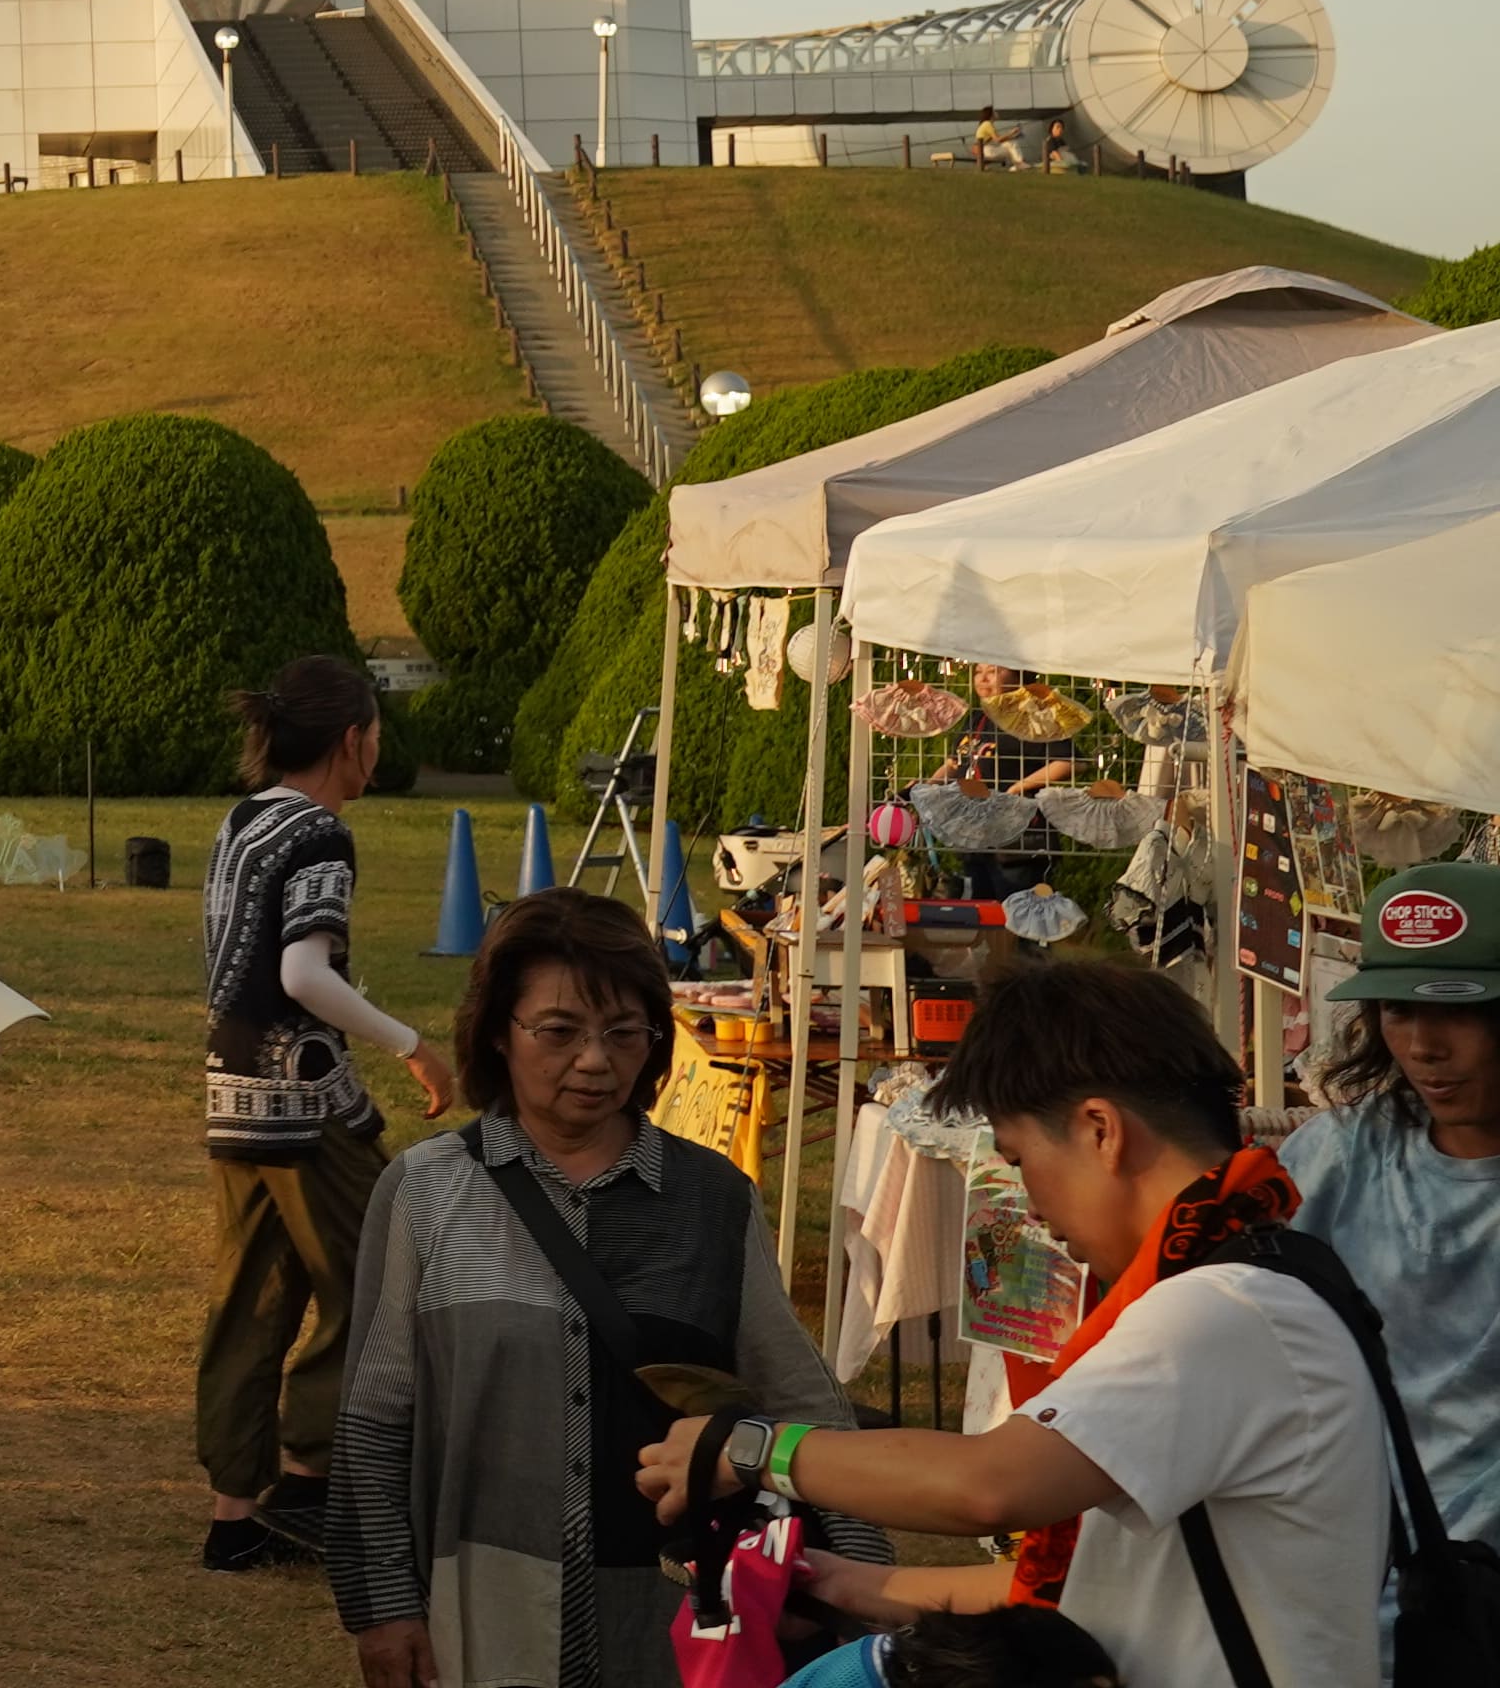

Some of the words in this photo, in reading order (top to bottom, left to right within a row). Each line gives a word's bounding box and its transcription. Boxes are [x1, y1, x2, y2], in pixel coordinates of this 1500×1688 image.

[1386, 905, 1412, 920] CHOP
[1414, 905, 1453, 919] STICKS
[1399, 920, 1412, 928] CAR
[1415, 920, 1433, 928] CLUB
